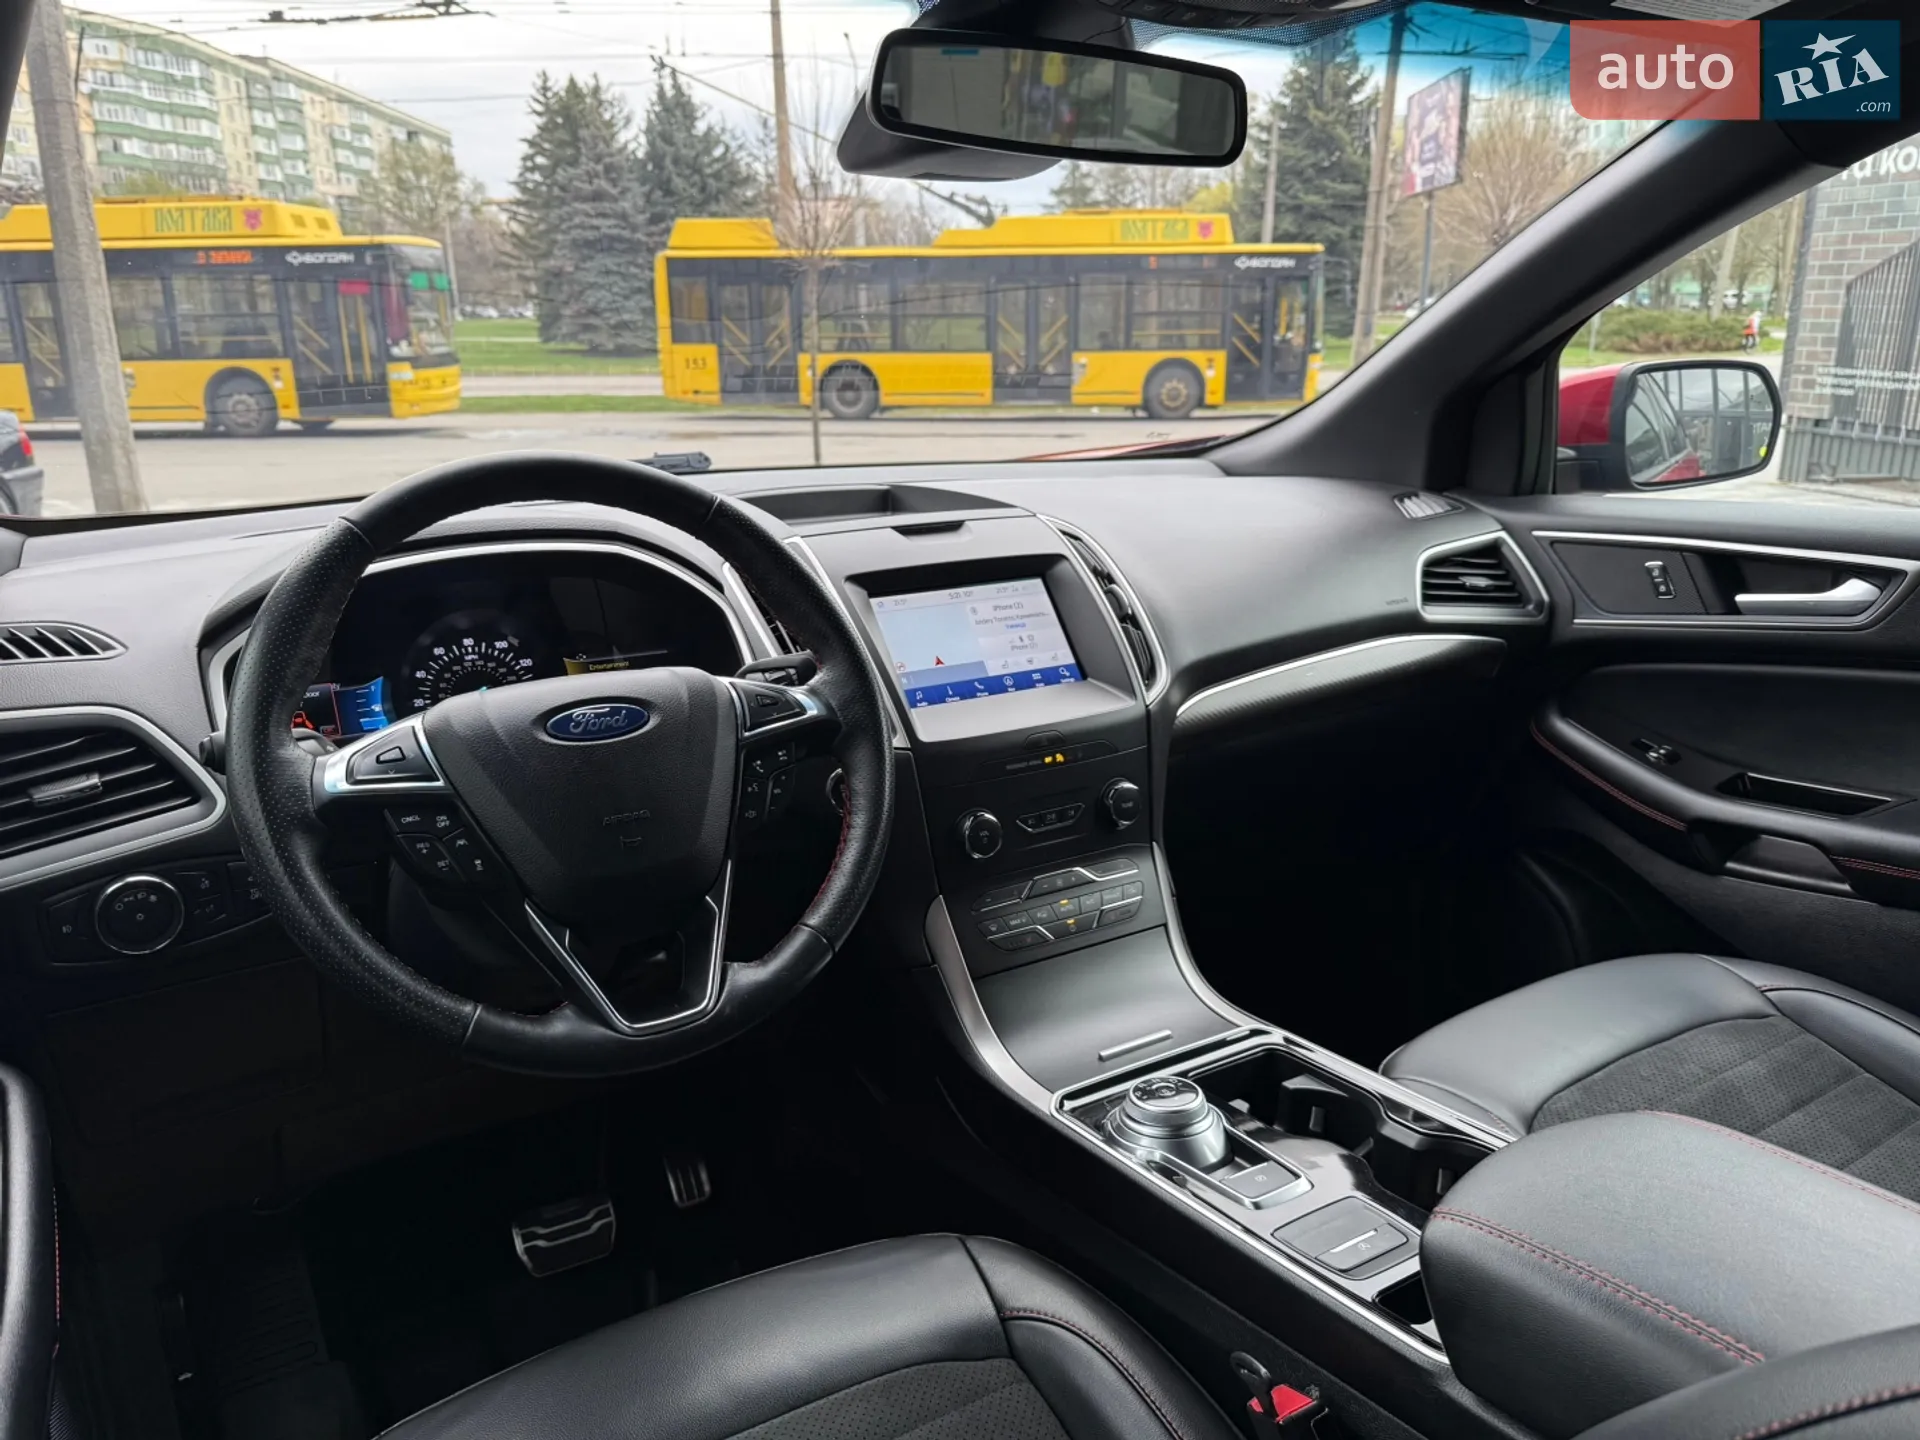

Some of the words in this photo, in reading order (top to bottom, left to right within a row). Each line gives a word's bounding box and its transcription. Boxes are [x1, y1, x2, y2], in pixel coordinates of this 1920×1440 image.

[494, 640, 509, 649] 100
[518, 658, 533, 667] 120
[589, 661, 630, 671] Entertainment
[415, 670, 426, 679] 40
[413, 698, 424, 707] 20
[569, 707, 628, 734] Ford
